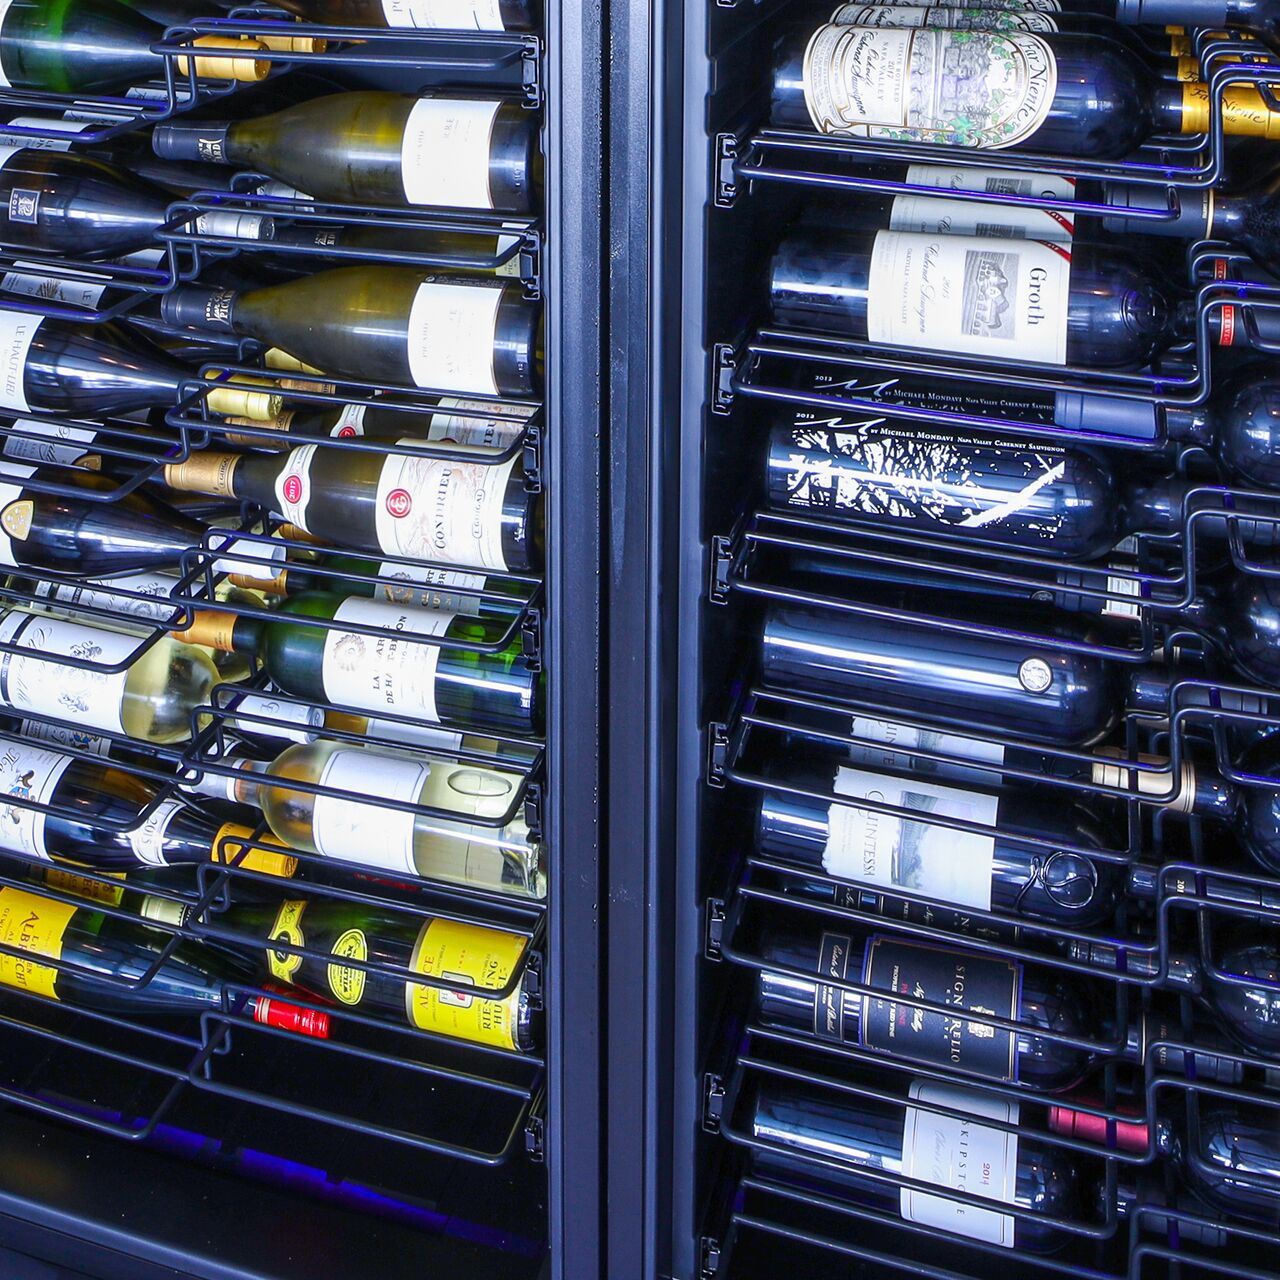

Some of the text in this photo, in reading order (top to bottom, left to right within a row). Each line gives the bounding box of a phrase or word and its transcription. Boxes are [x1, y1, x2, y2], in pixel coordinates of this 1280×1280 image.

[850, 30, 878, 116] Cabernet Sauvignon
[876, 40, 890, 101] NAPA VALLEY
[1016, 41, 1048, 124] Far Niente
[10, 194, 20, 216] 2016
[912, 242, 941, 334] Cabernet Sauvignon
[1027, 266, 1049, 327] Groth
[4, 325, 27, 397] LE HAUT-LIEU
[880, 427, 915, 439] MICHAEL
[916, 431, 954, 442] MONDAVI
[972, 438, 993, 446] VALLEY
[994, 440, 1026, 450] CABERNET
[1028, 443, 1066, 453] SAUVIGNON
[288, 481, 297, 499] 2017
[433, 469, 453, 550] CONDRIEU
[371, 675, 381, 690] LA
[385, 690, 395, 704] DE
[948, 964, 966, 1063] SIGNRELLO
[979, 1161, 992, 1185] 2014
